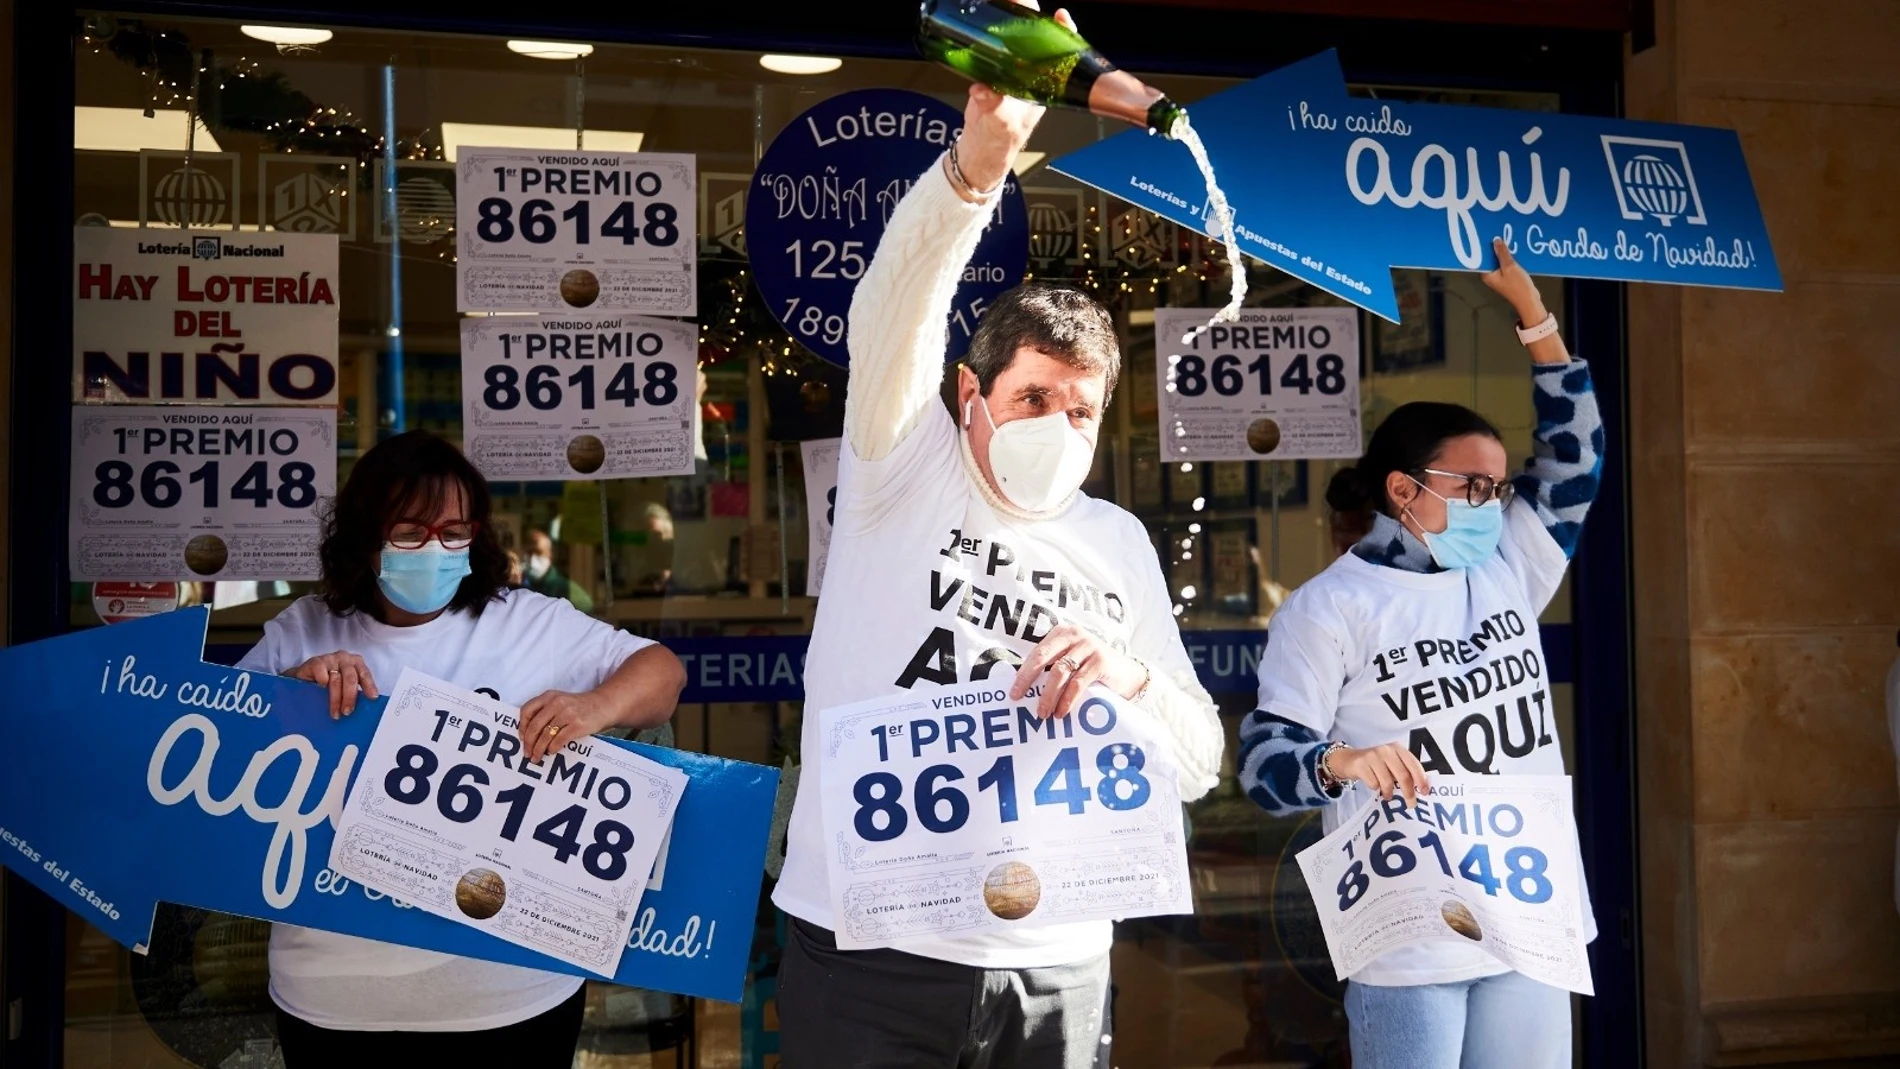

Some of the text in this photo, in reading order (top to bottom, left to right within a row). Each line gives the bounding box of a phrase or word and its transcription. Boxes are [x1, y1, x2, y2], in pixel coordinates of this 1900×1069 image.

[521, 167, 662, 197] PREMIO
[538, 156, 620, 167] VENDIDO AQUÍ
[1345, 125, 1571, 270] aquí
[477, 197, 679, 247] 86148
[1526, 224, 1608, 260] Gordo
[1614, 230, 1643, 262] de
[138, 242, 284, 258] Lotería Nacional
[786, 239, 866, 280] 125
[1235, 224, 1373, 296] Apuestas del Estado
[174, 311, 242, 337] DEL
[526, 332, 663, 360] PREMIO
[542, 319, 622, 331] VENDIDO AQUÍ
[1211, 325, 1331, 349] PREMIO
[83, 342, 336, 400] NIÑO
[483, 361, 678, 411] 86148
[1176, 354, 1346, 397] 86148
[163, 413, 253, 425] VENDIDO AQUÍ
[143, 428, 299, 455] PREMIO
[93, 460, 317, 509] 86148
[1415, 609, 1526, 668] PREMIO
[177, 672, 272, 718] caído
[932, 689, 1006, 710] VENDIDO
[1381, 648, 1540, 722] VENDIDO
[910, 697, 1117, 762] PREMIO
[1406, 681, 1553, 776] AQUÍ
[458, 720, 633, 811] PREMIO
[383, 744, 635, 880] 86148
[853, 743, 1151, 842] 86148
[1364, 795, 1524, 840] PREMIO
[43, 861, 70, 883] del
[69, 878, 120, 920] Estado
[404, 864, 438, 881] NAVIDAD
[1089, 874, 1136, 886] DICIEMBRE
[1336, 830, 1553, 912] 86148
[920, 896, 962, 908] NAVIDAD
[519, 907, 528, 915] 22
[541, 916, 581, 936] DICIEMBRE
[582, 931, 600, 942] 2021
